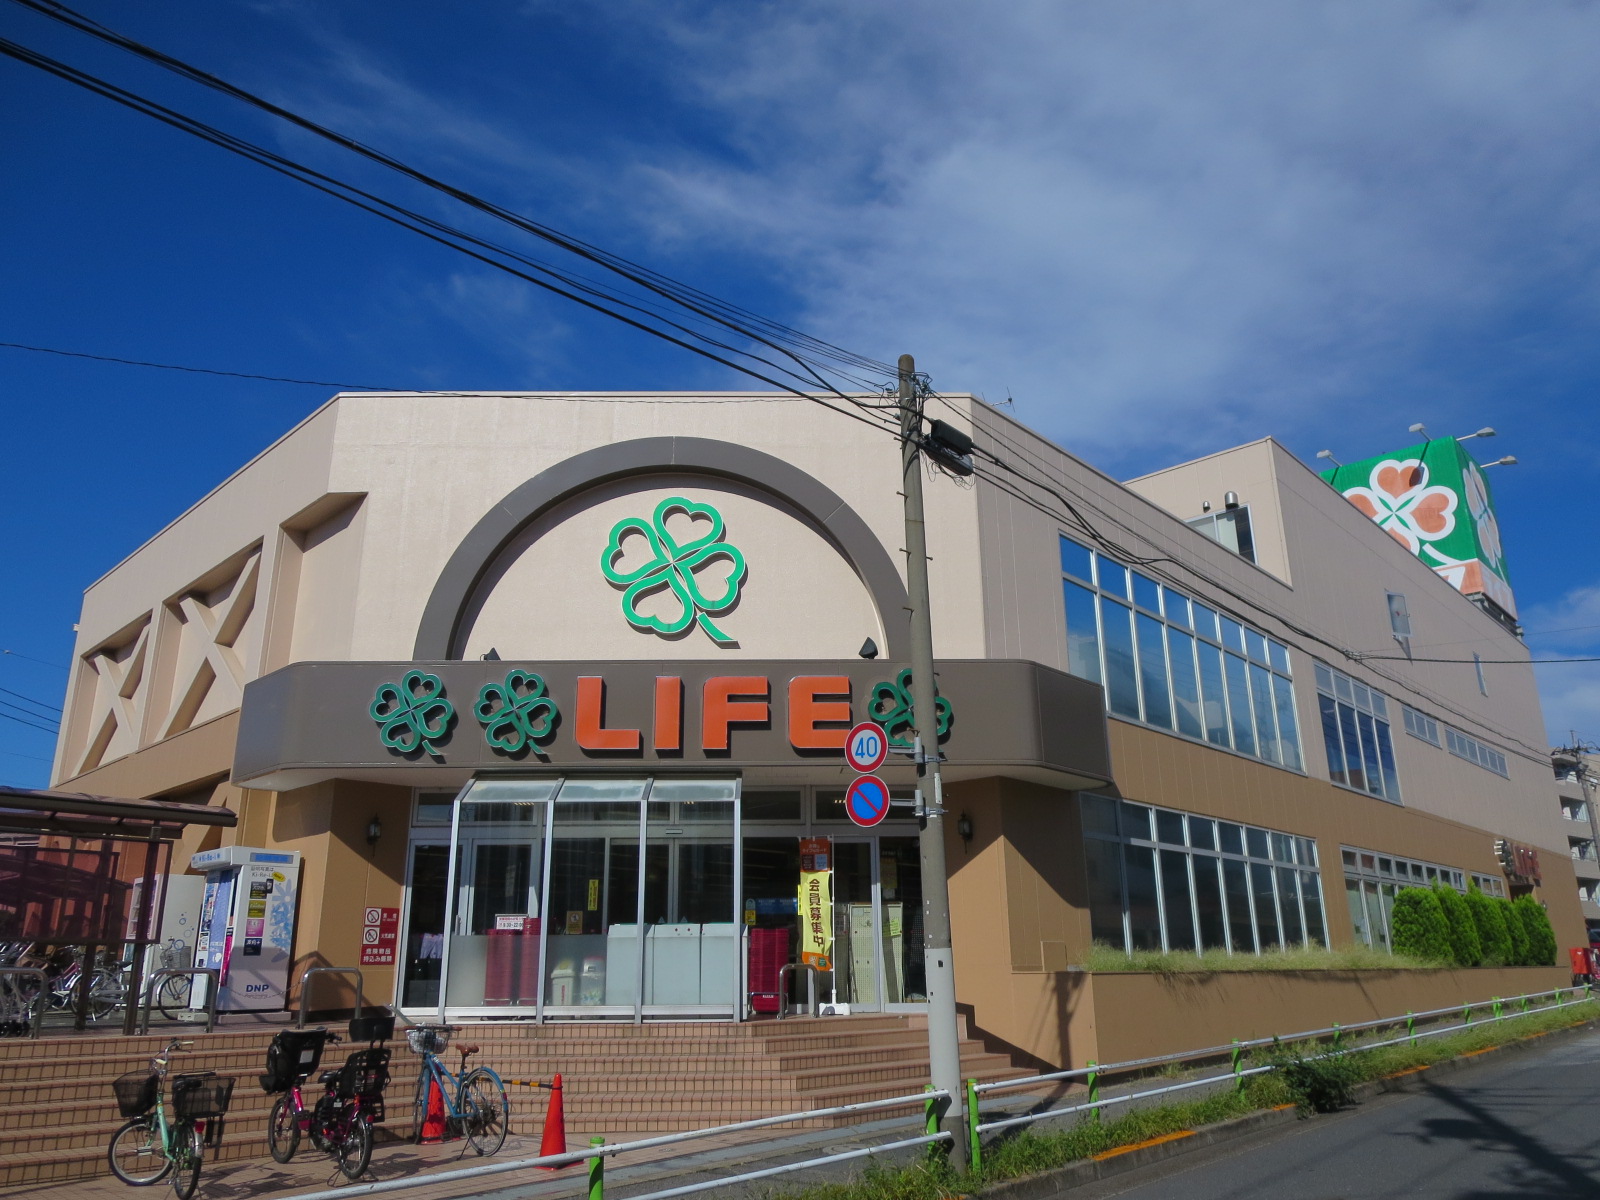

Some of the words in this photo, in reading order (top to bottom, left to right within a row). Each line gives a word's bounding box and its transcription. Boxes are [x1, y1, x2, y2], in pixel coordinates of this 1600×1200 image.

[575, 675, 850, 750] LIFE
[855, 737, 878, 759] 40
[809, 878, 824, 947] 会員募集中
[246, 984, 270, 993] DNP
